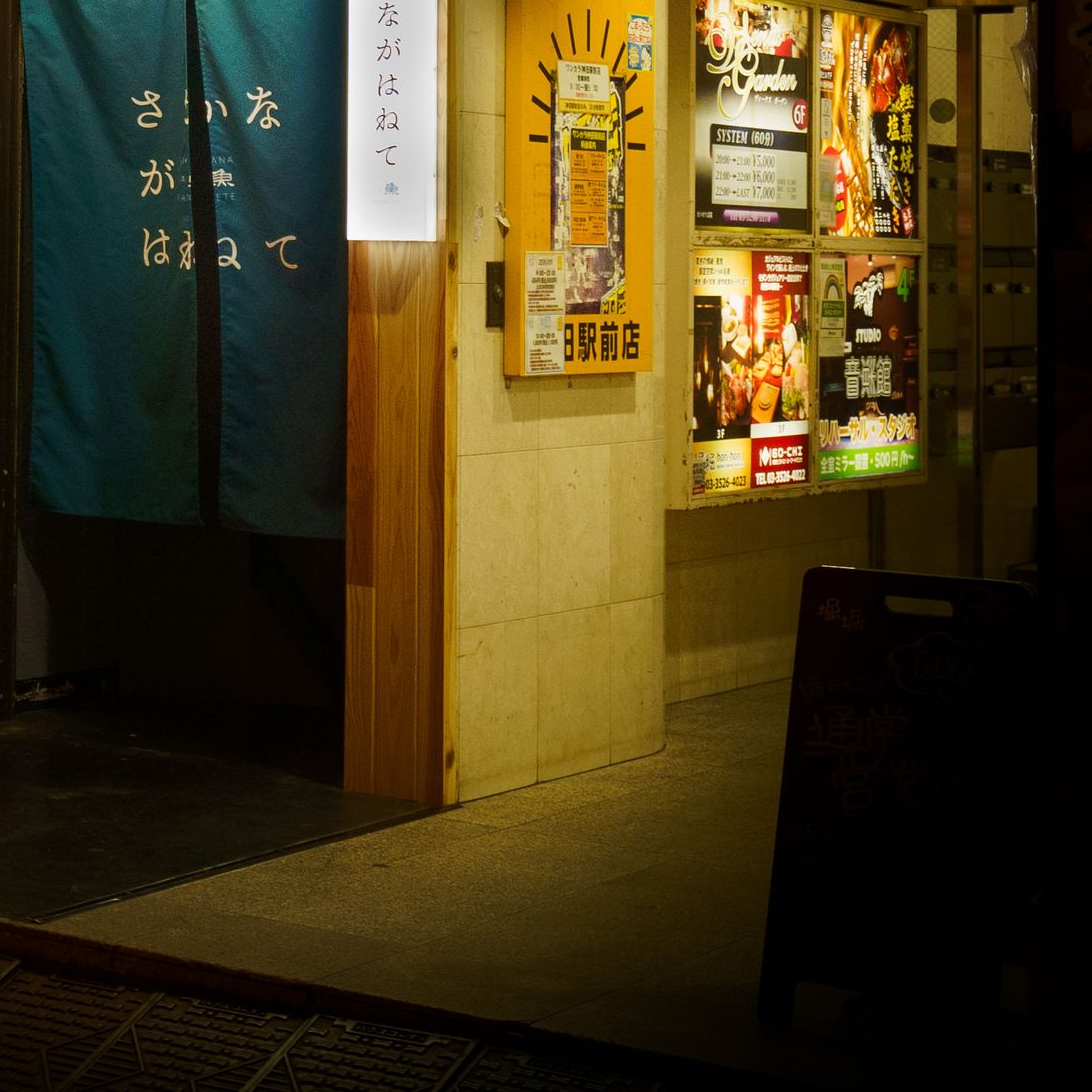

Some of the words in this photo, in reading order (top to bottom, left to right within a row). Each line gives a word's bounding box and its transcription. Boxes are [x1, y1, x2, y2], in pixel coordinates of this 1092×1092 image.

[793, 105, 807, 125] 6F
[716, 128, 749, 146] SYSTEM
[750, 131, 774, 148] (60分)
[139, 158, 176, 198] が
[855, 328, 882, 344] STUDIO
[818, 412, 917, 448] リハーサル・スタジオ
